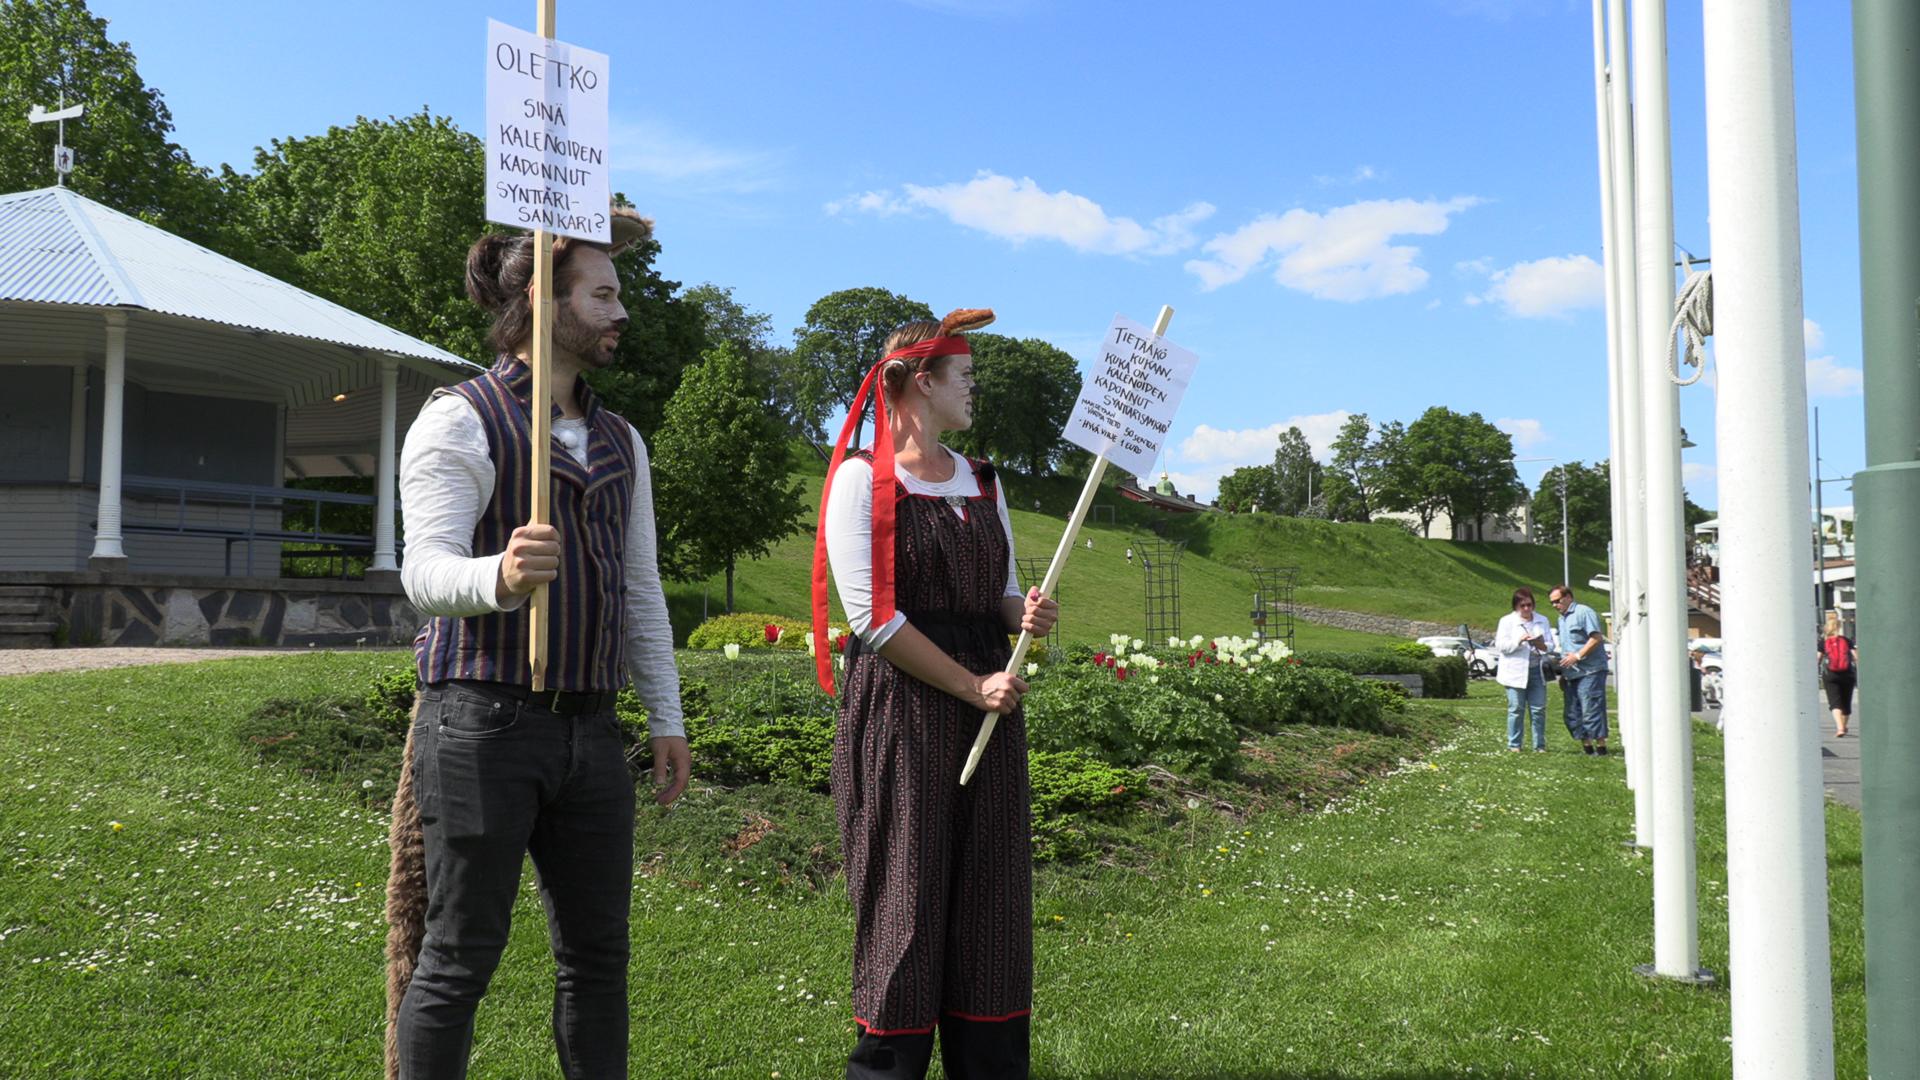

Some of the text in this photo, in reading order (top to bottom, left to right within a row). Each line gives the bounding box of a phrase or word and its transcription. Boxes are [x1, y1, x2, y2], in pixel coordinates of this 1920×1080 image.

[496, 42, 598, 94] OLETKO
[523, 98, 566, 127] SINÄ
[500, 123, 602, 165] KALENOIDEN
[500, 152, 592, 187] KADONNUT
[496, 181, 580, 211] SYNTTÄRI-
[518, 206, 606, 233] SANKARI?
[1104, 352, 1150, 382] KUKA ON
[1094, 375, 1155, 410] KADONNUT
[1106, 366, 1168, 403] KALENOIDEN
[1123, 426, 1135, 438] 50
